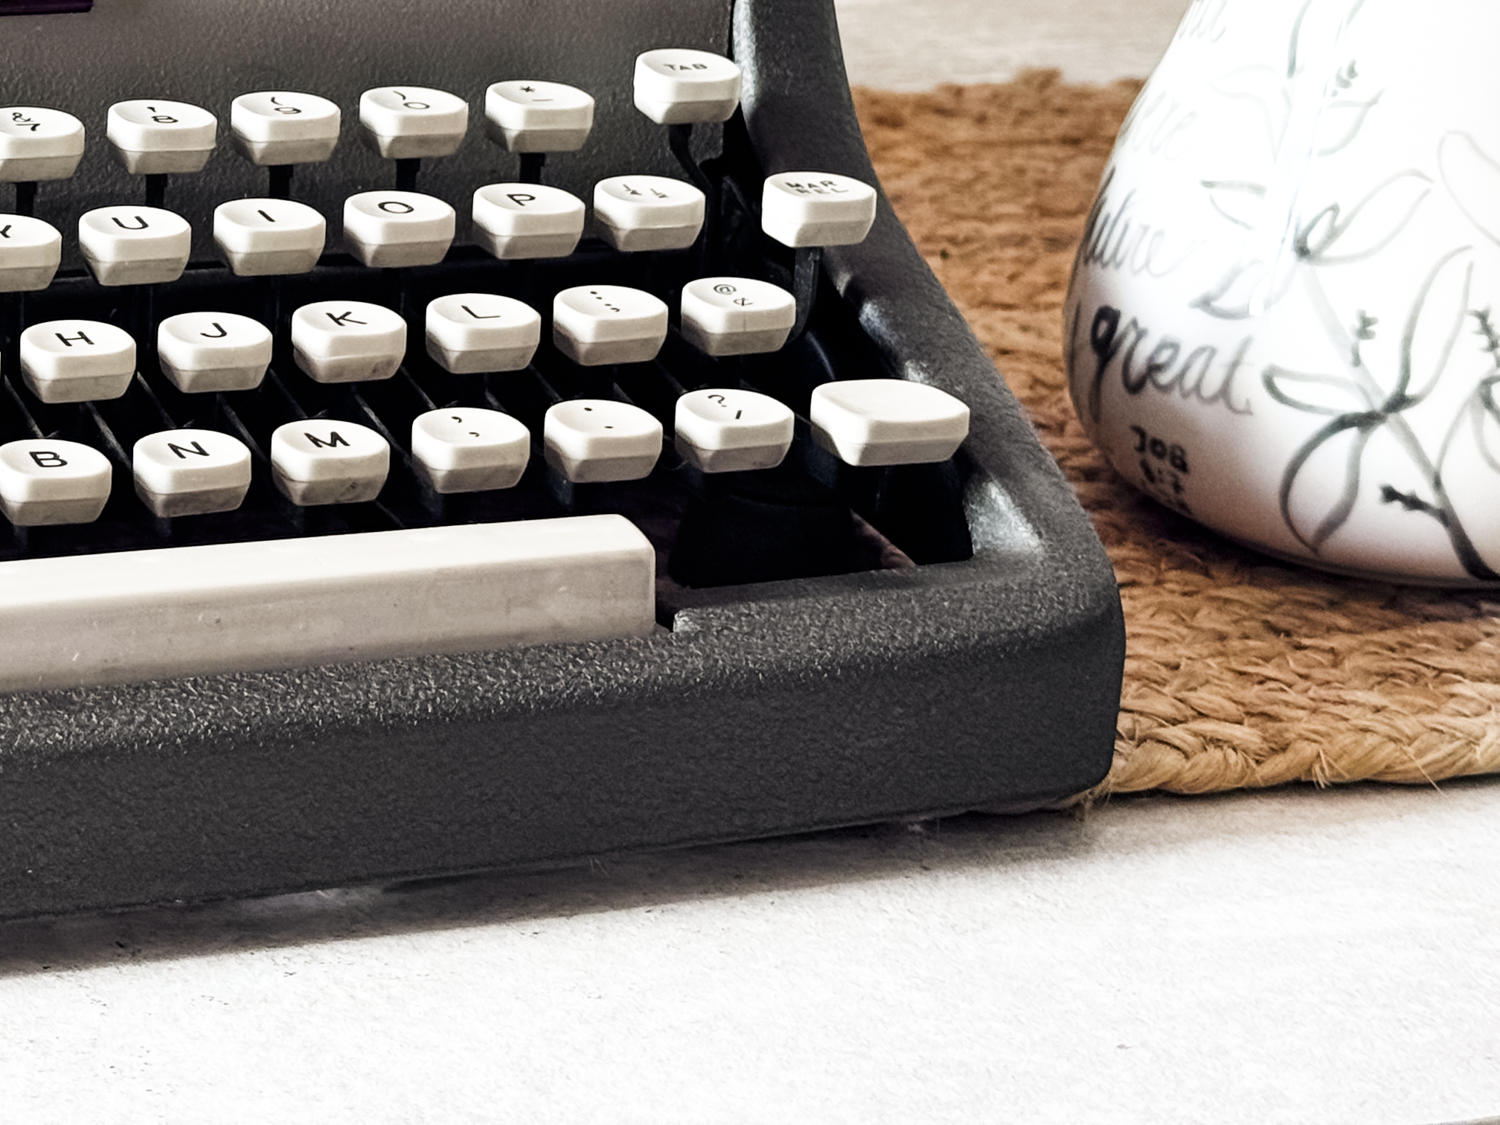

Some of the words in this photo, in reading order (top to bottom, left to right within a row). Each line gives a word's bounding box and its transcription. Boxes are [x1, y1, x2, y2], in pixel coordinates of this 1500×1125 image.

[663, 63, 708, 72] TAB
[377, 200, 415, 215] O
[505, 193, 537, 207] P
[110, 215, 150, 231] U
[256, 209, 276, 223] I
[712, 283, 737, 296] @
[325, 310, 368, 327] K
[460, 304, 501, 320] L
[54, 330, 95, 348] H
[199, 322, 228, 339] J
[1088, 305, 1254, 423] great
[303, 430, 351, 449] M
[166, 440, 211, 460] N
[1128, 424, 1193, 476] JOB
[28, 450, 69, 469] B
